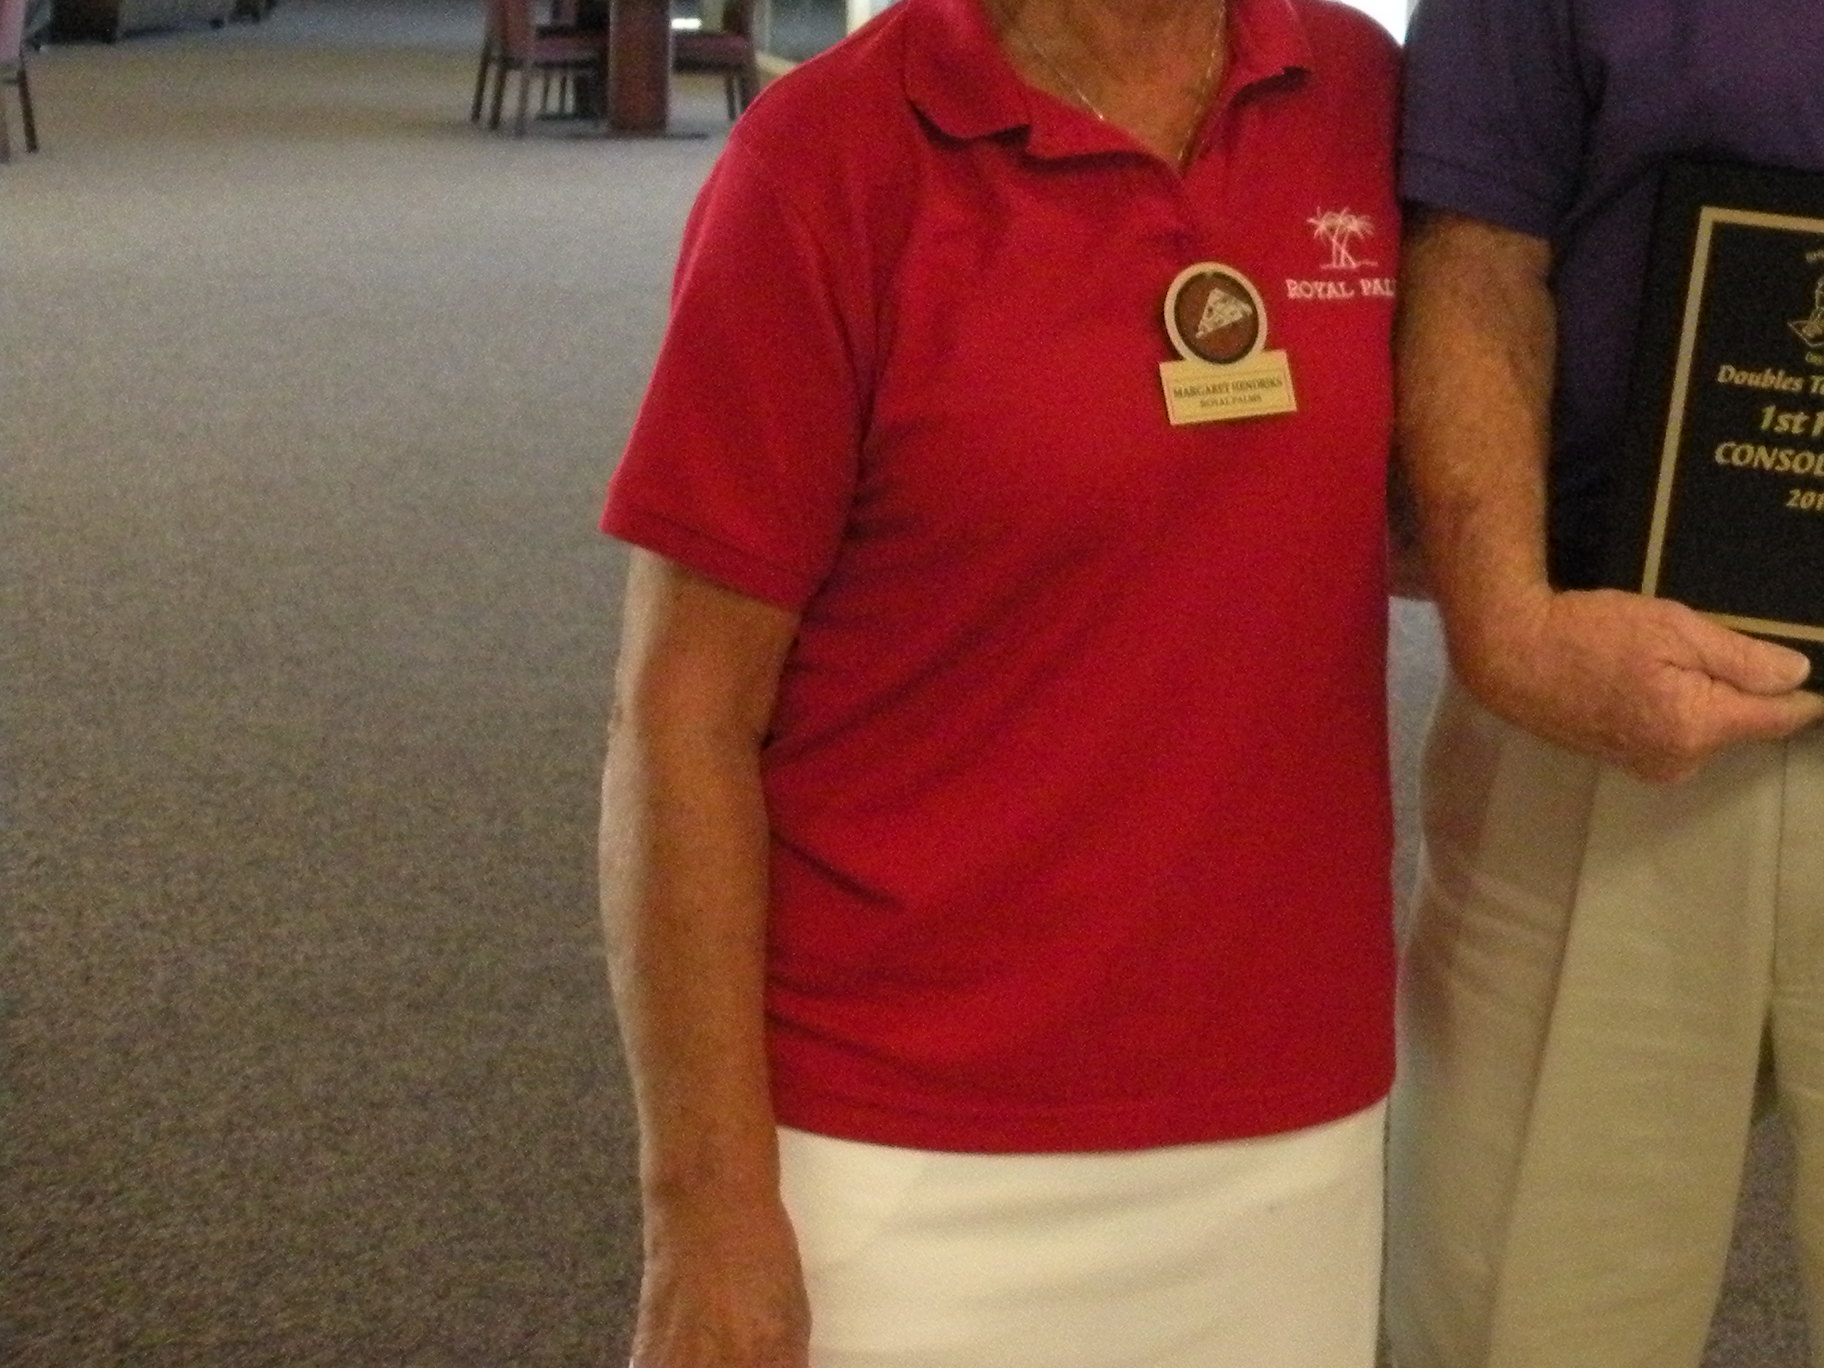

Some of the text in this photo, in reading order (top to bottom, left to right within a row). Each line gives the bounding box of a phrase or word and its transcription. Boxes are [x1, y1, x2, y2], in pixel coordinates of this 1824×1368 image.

[1285, 278, 1355, 300] ROYAL
[1716, 363, 1803, 394] Doubles
[1760, 405, 1809, 434] 1st
